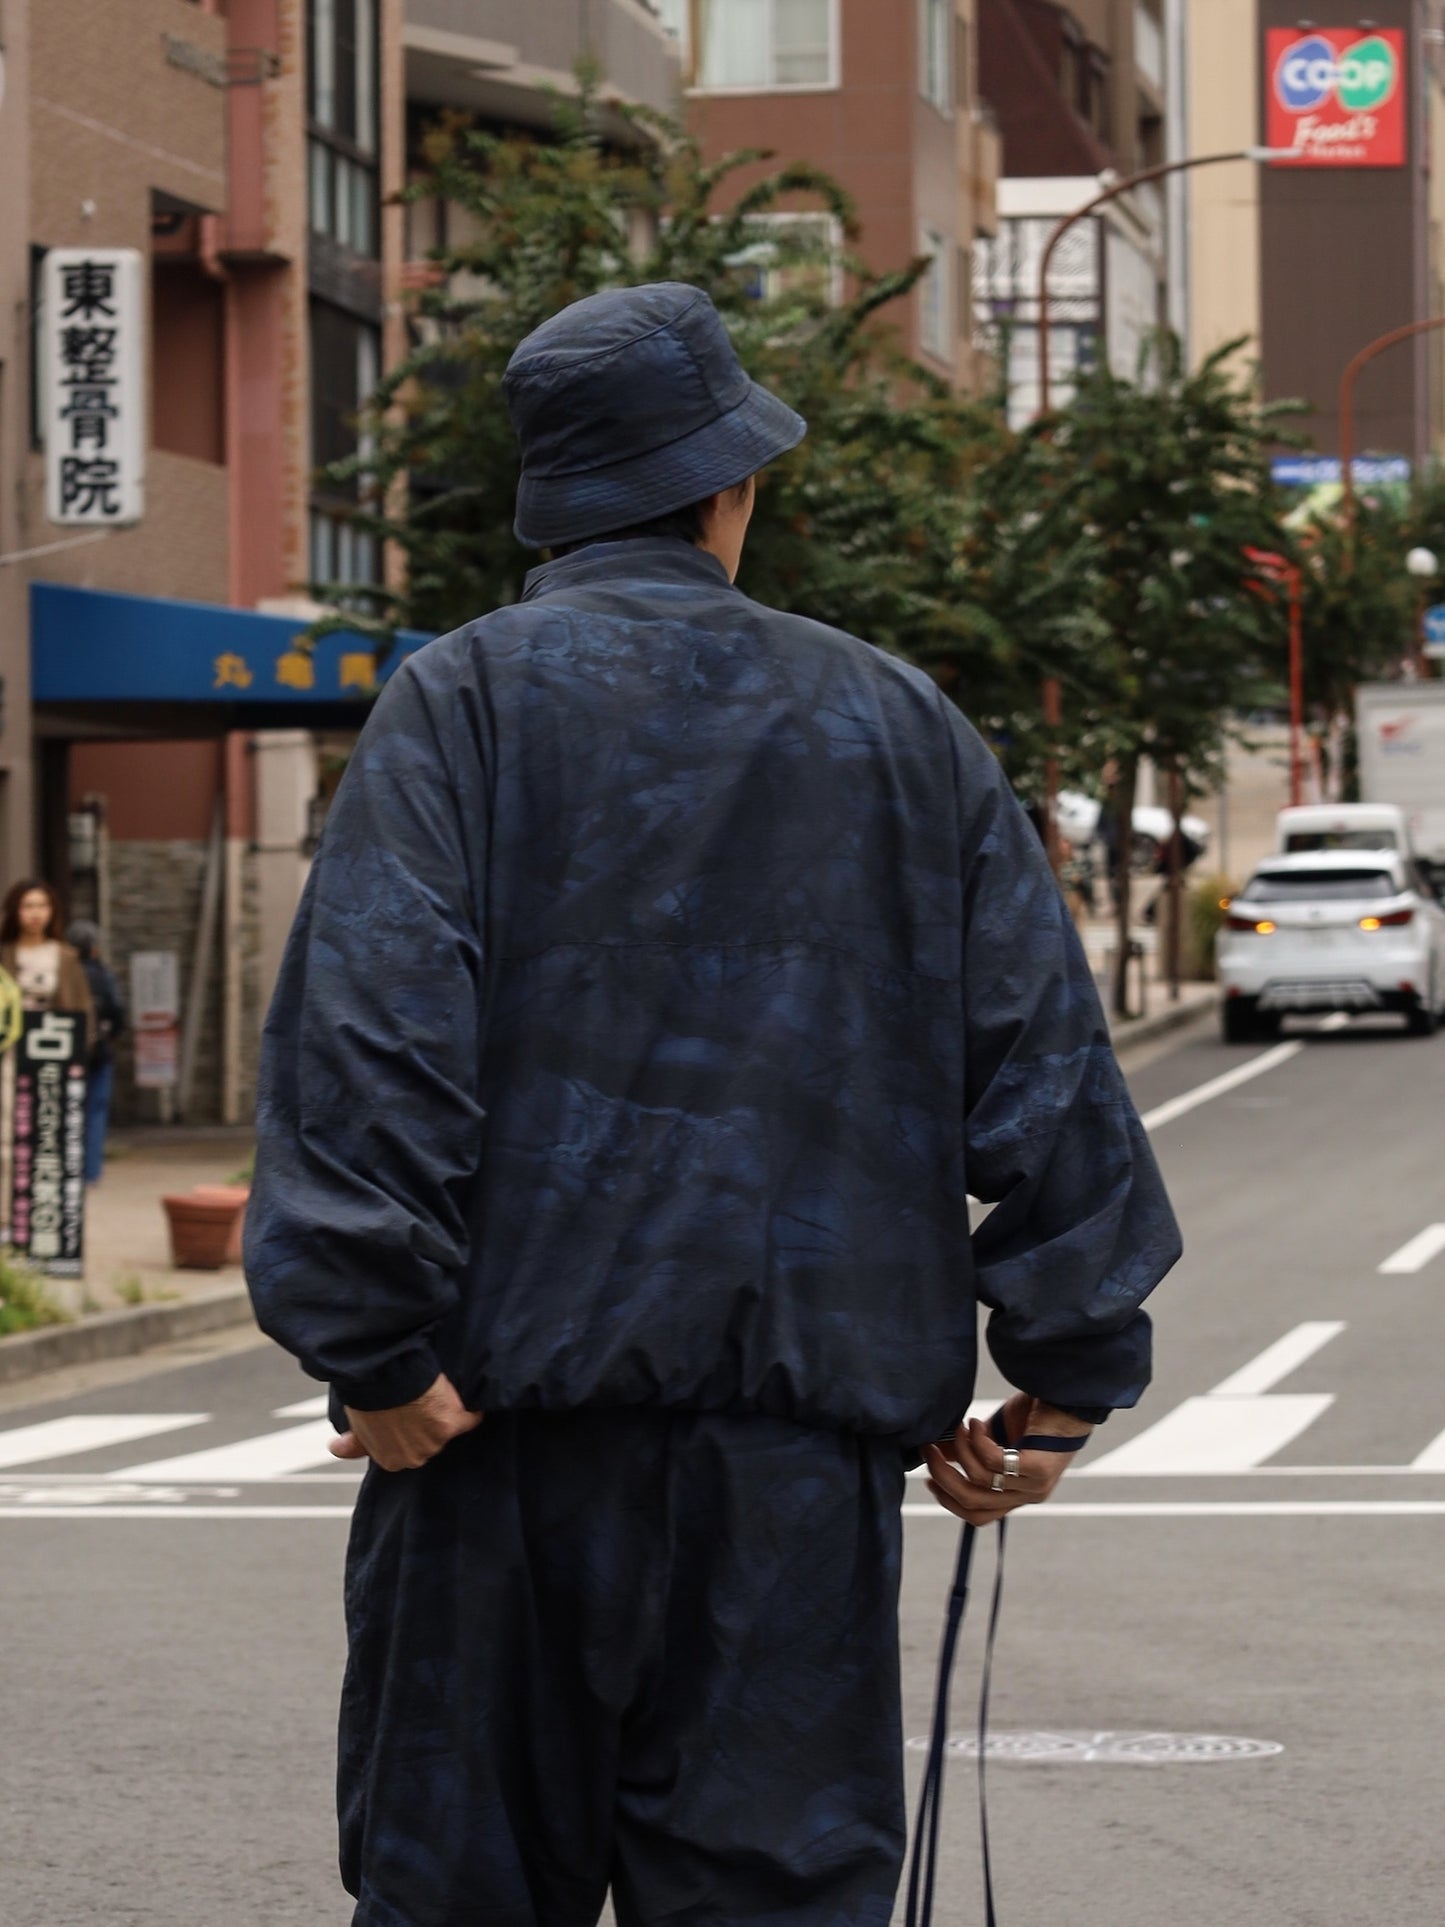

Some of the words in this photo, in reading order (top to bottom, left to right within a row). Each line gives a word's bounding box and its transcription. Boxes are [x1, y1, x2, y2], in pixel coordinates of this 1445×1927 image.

[58, 260, 119, 515] 東整骨院
[27, 1013, 75, 1060] 占
